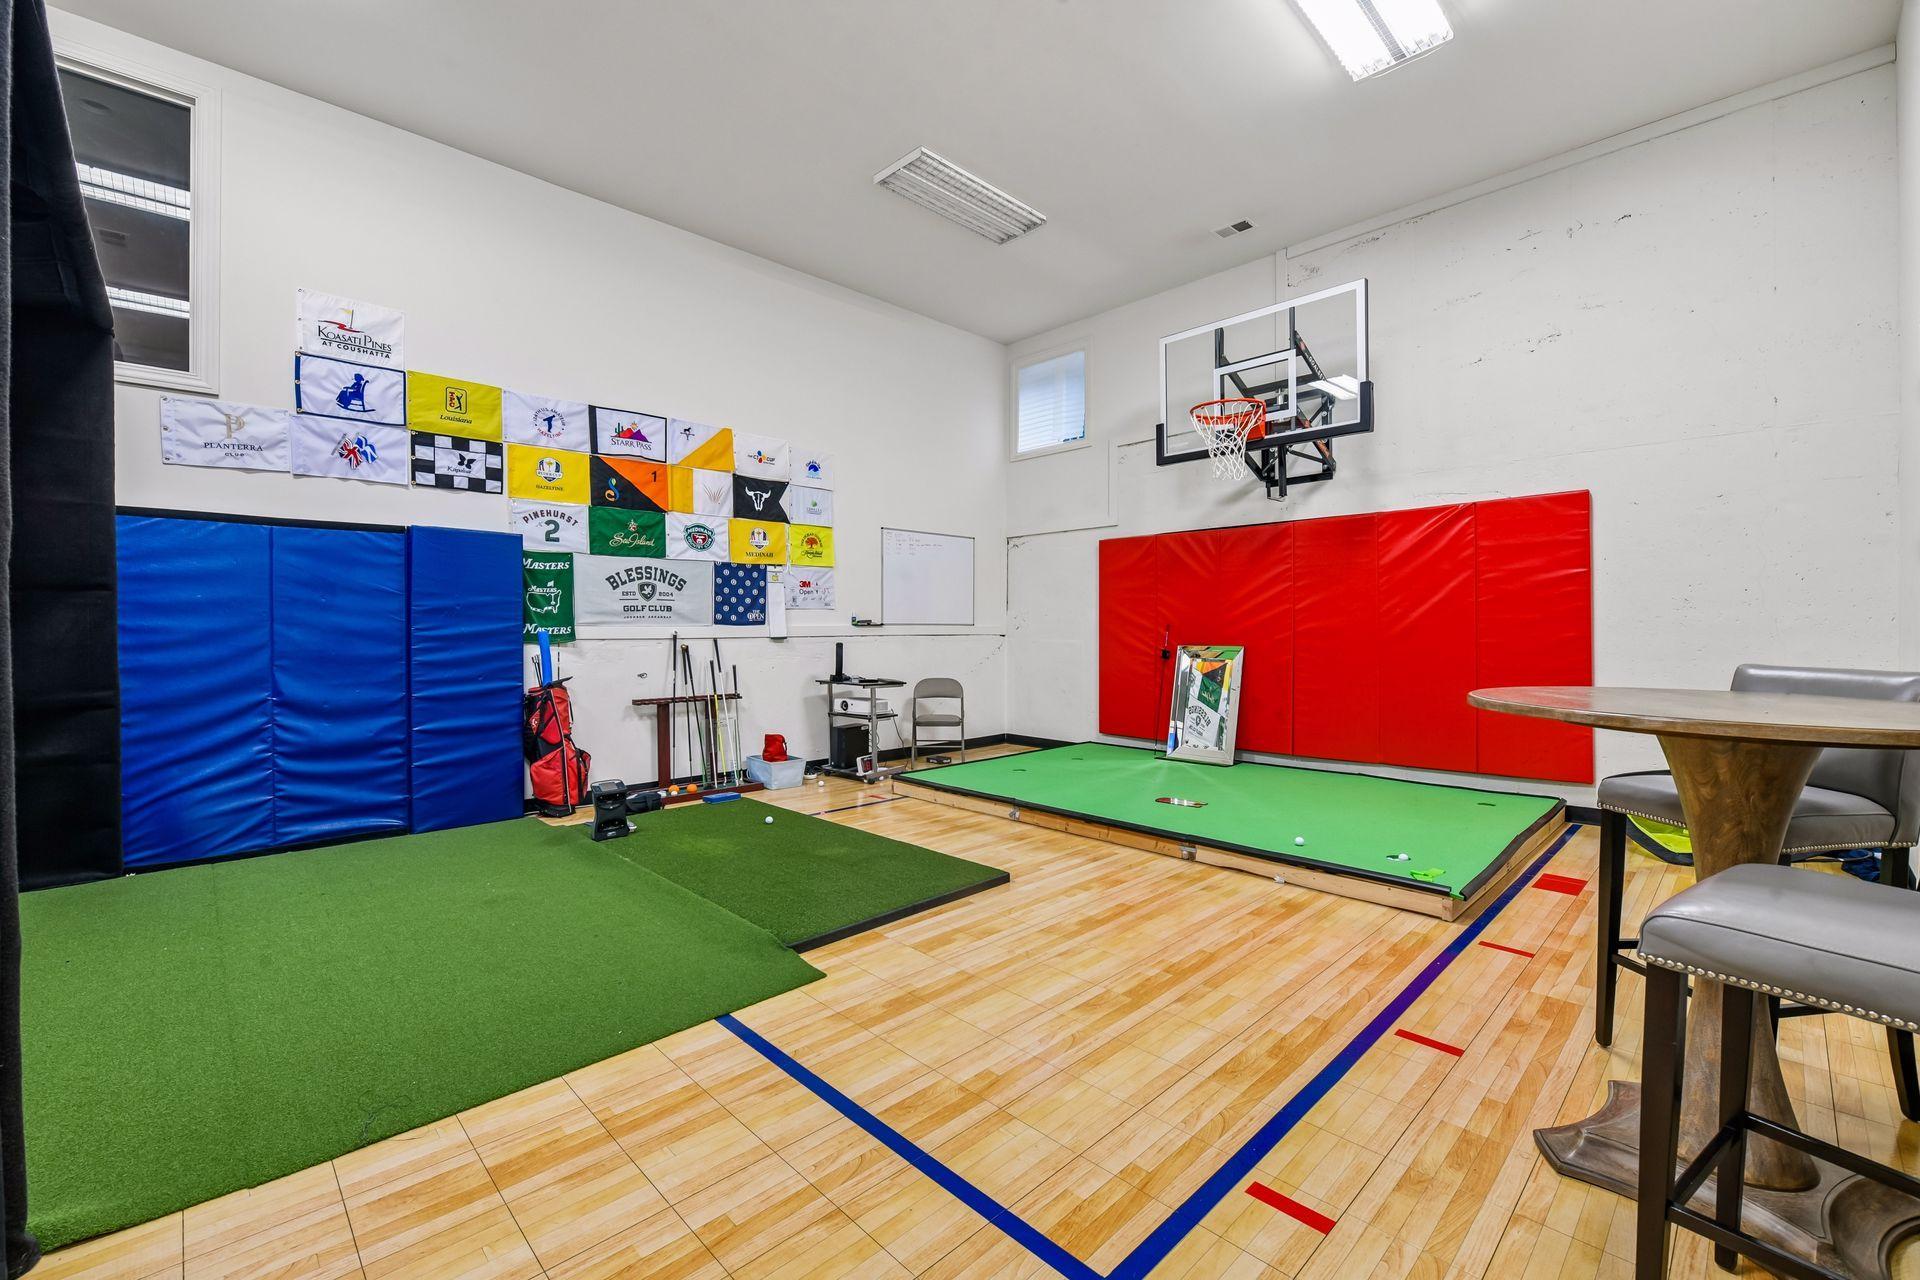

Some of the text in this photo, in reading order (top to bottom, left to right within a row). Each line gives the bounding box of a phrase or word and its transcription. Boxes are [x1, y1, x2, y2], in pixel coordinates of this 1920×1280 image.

[336, 344, 391, 359] COUSHATTA
[440, 414, 473, 424] Louisiana
[203, 442, 264, 452] PLANTERRA
[652, 470, 657, 482] 1
[522, 510, 578, 526] PINEHURST
[544, 520, 560, 542] 2
[605, 566, 687, 592] BLESSINGS
[747, 612, 764, 621] OPEN
